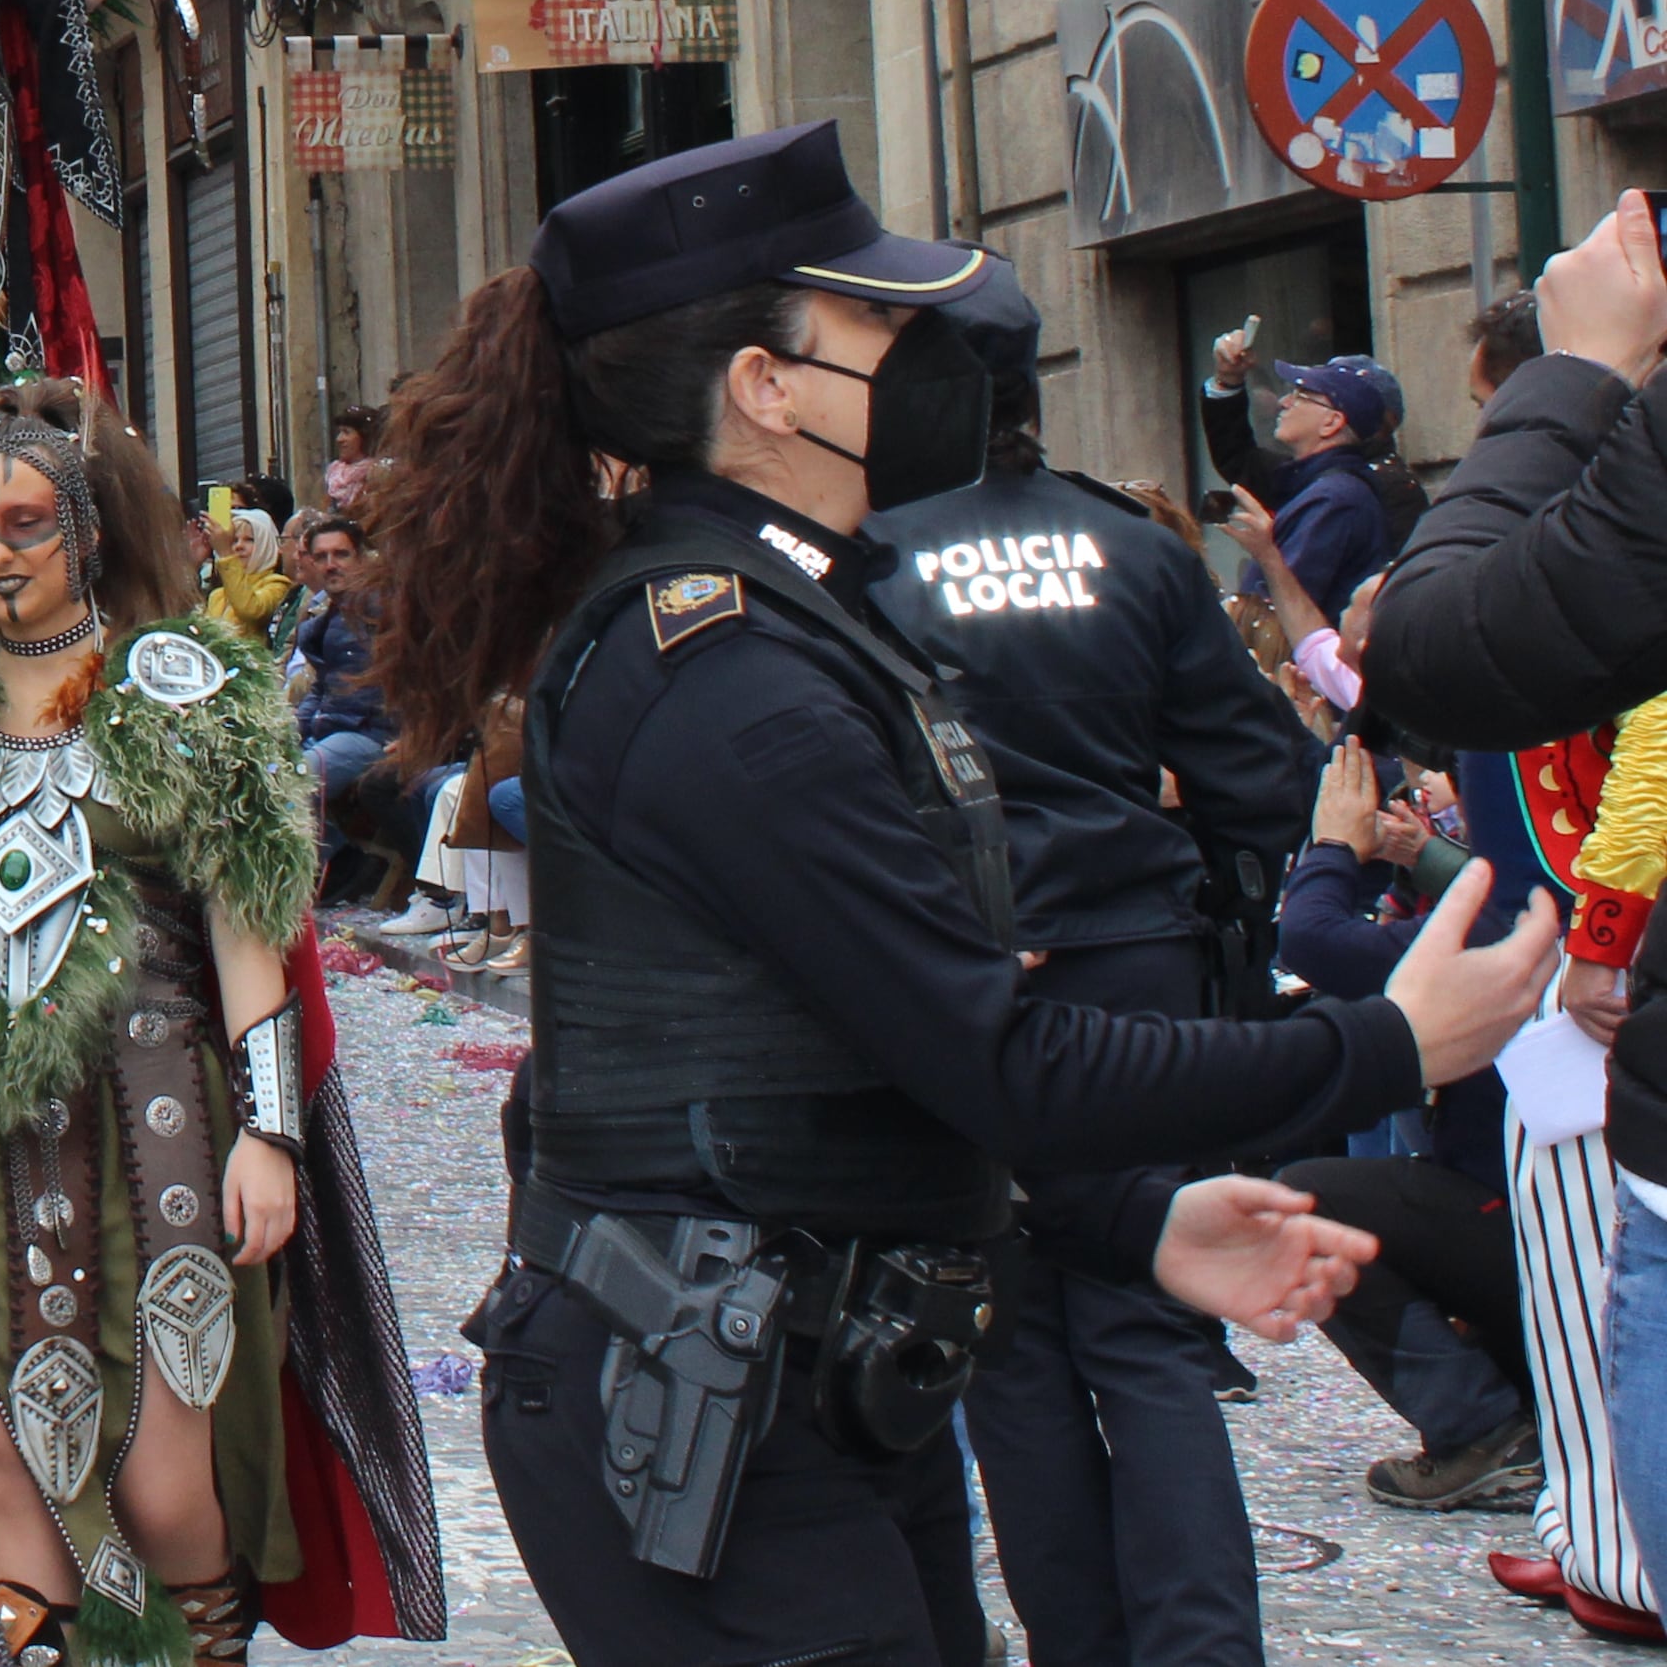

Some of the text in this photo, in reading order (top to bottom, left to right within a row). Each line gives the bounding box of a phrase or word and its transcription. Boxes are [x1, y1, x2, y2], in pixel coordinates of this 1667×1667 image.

[569, 5, 722, 44] ITALIANA
[338, 85, 403, 110] Don
[759, 523, 833, 576] POLICIA
[915, 533, 1107, 583] POLICIA
[942, 570, 1099, 616] LOCAL
